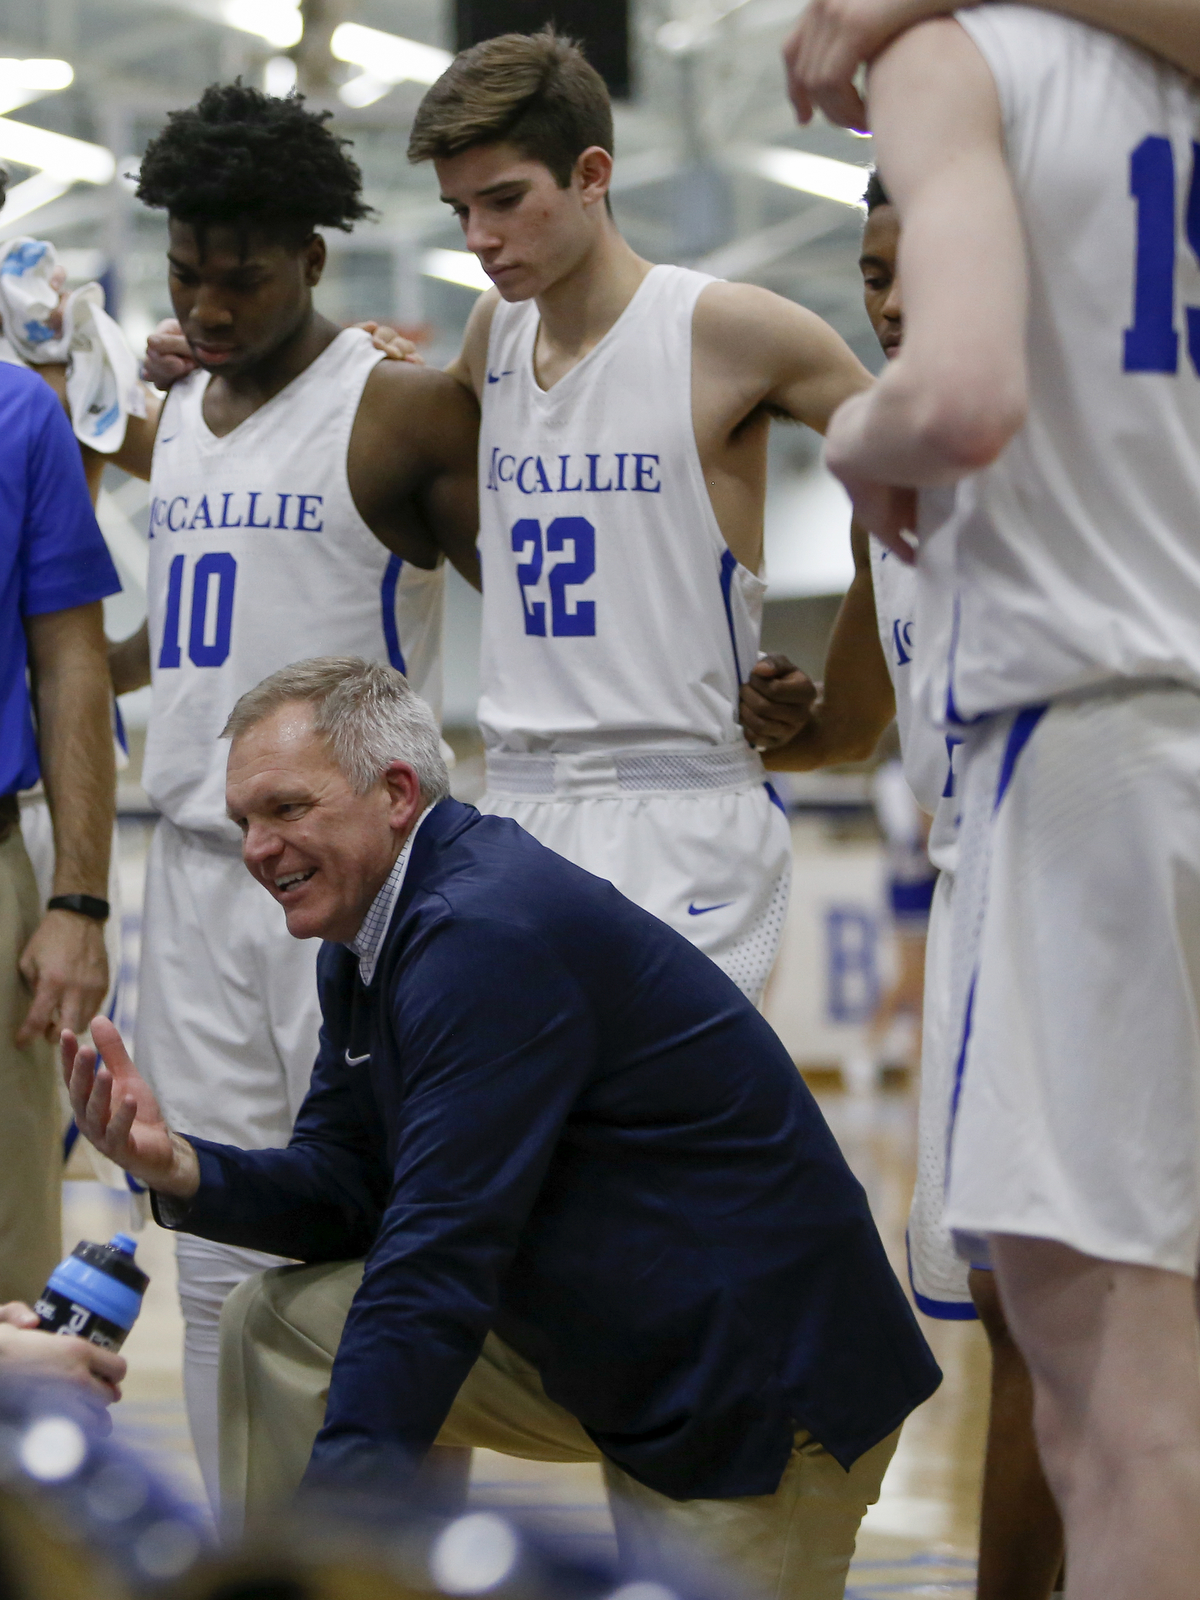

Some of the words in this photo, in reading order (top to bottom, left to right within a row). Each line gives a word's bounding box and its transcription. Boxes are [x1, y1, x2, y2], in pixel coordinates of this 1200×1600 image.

[1122, 133, 1200, 378] 1
[158, 551, 238, 670] 10
[511, 515, 597, 638] 22
